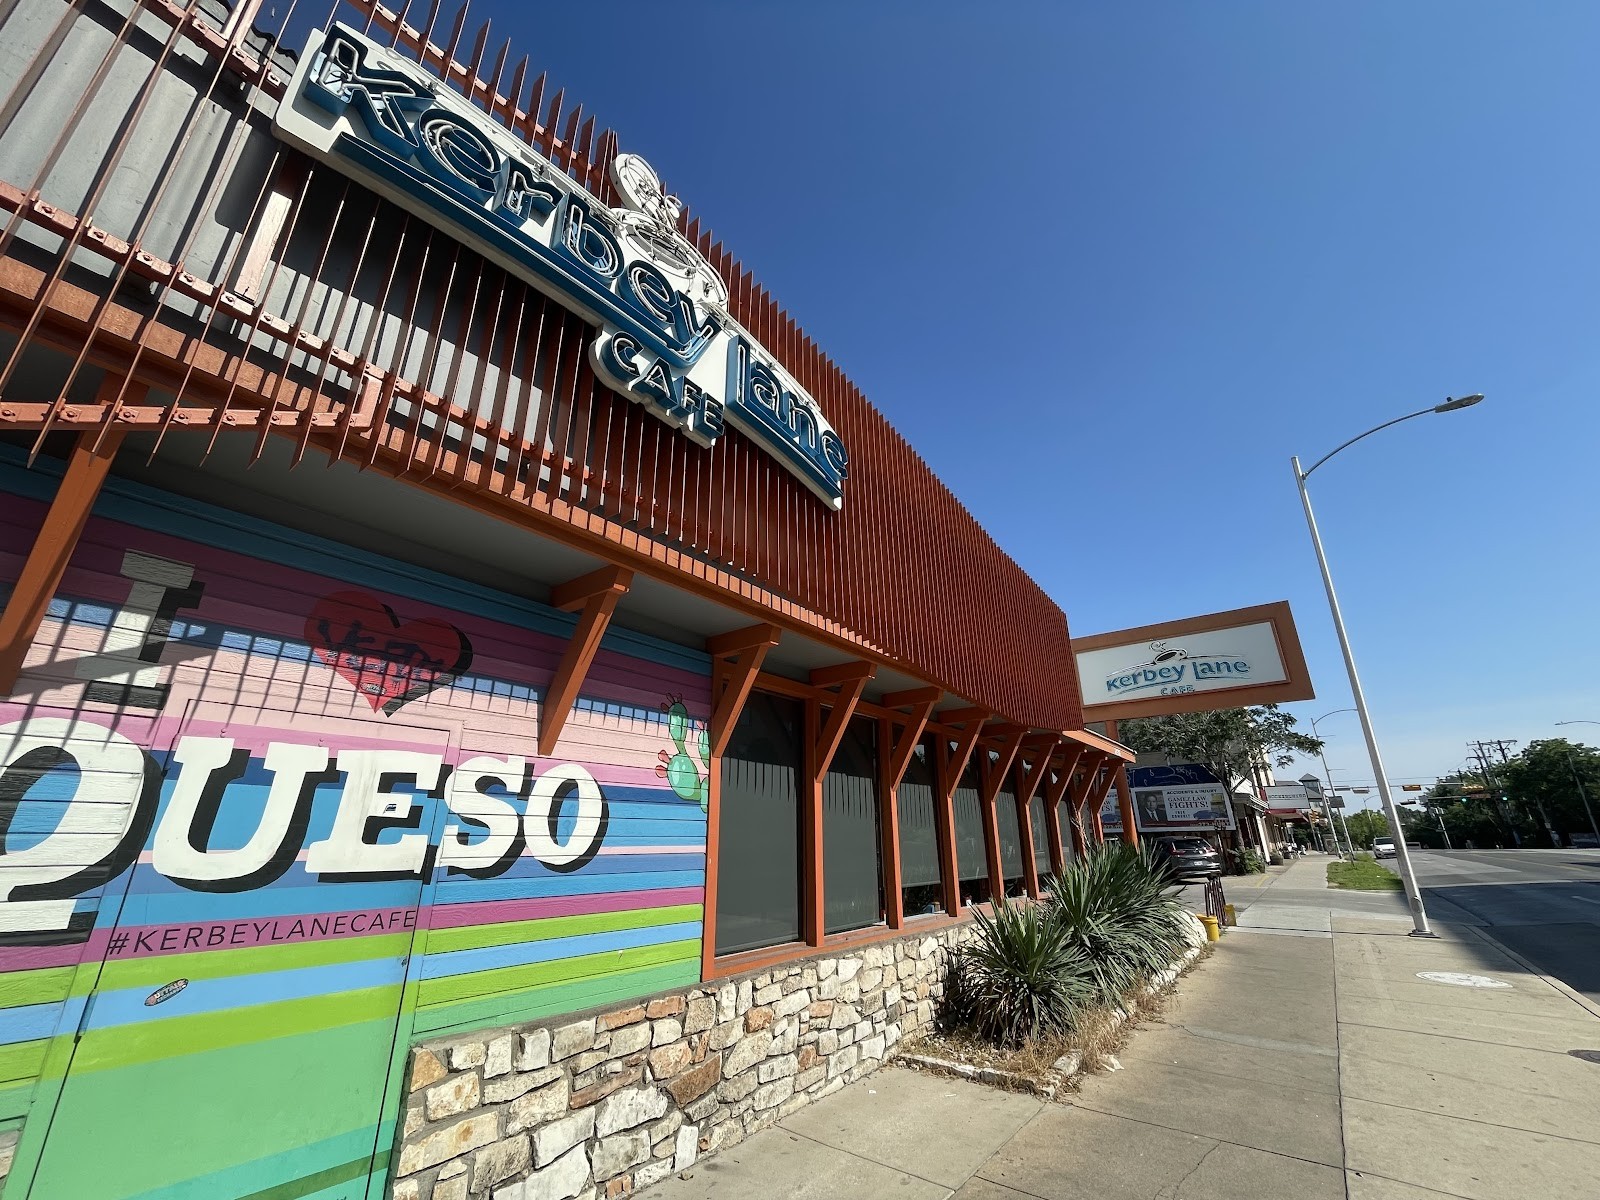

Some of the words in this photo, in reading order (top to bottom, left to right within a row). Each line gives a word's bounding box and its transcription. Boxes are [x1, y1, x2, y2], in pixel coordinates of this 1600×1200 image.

[601, 331, 725, 437] CAFE
[1160, 685, 1195, 696] CAFE
[0, 717, 606, 934] QUESO
[1169, 801, 1209, 809] FIGHTS!
[107, 909, 417, 956] #KERBEYLANECAFE
